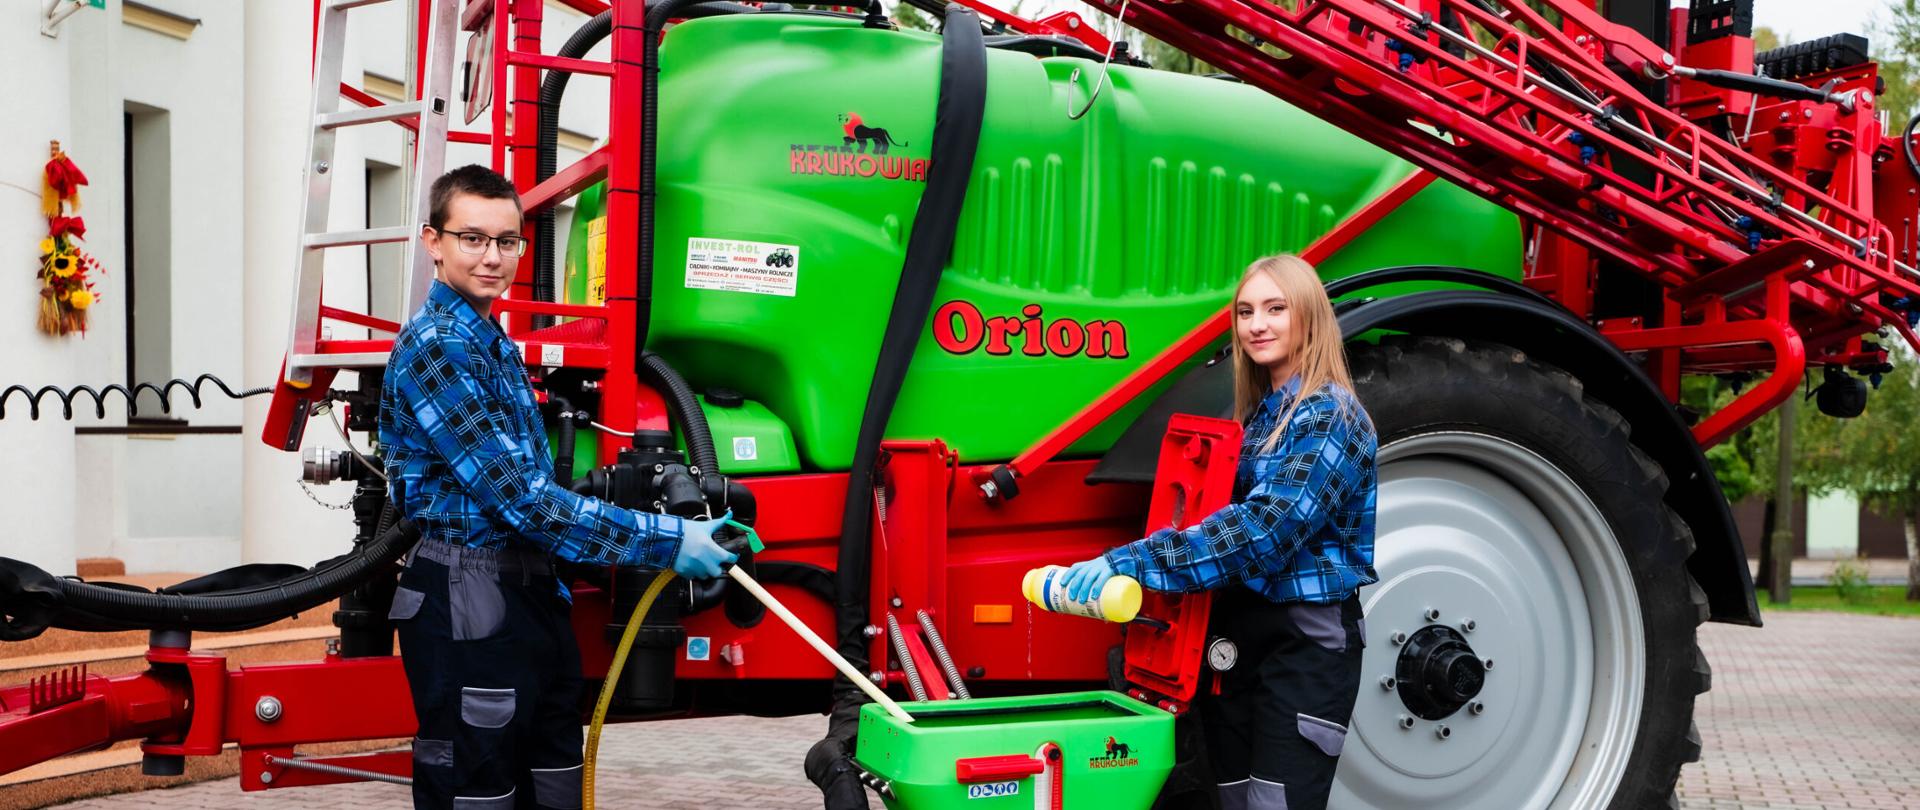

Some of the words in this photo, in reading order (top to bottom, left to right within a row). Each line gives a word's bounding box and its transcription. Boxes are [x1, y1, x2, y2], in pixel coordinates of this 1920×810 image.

[691, 240, 759, 253] INVEST-ROL
[769, 269, 793, 277] ROLNICZE
[933, 300, 1129, 358] Orion
[1090, 758, 1138, 768] KRUKOWIAK
